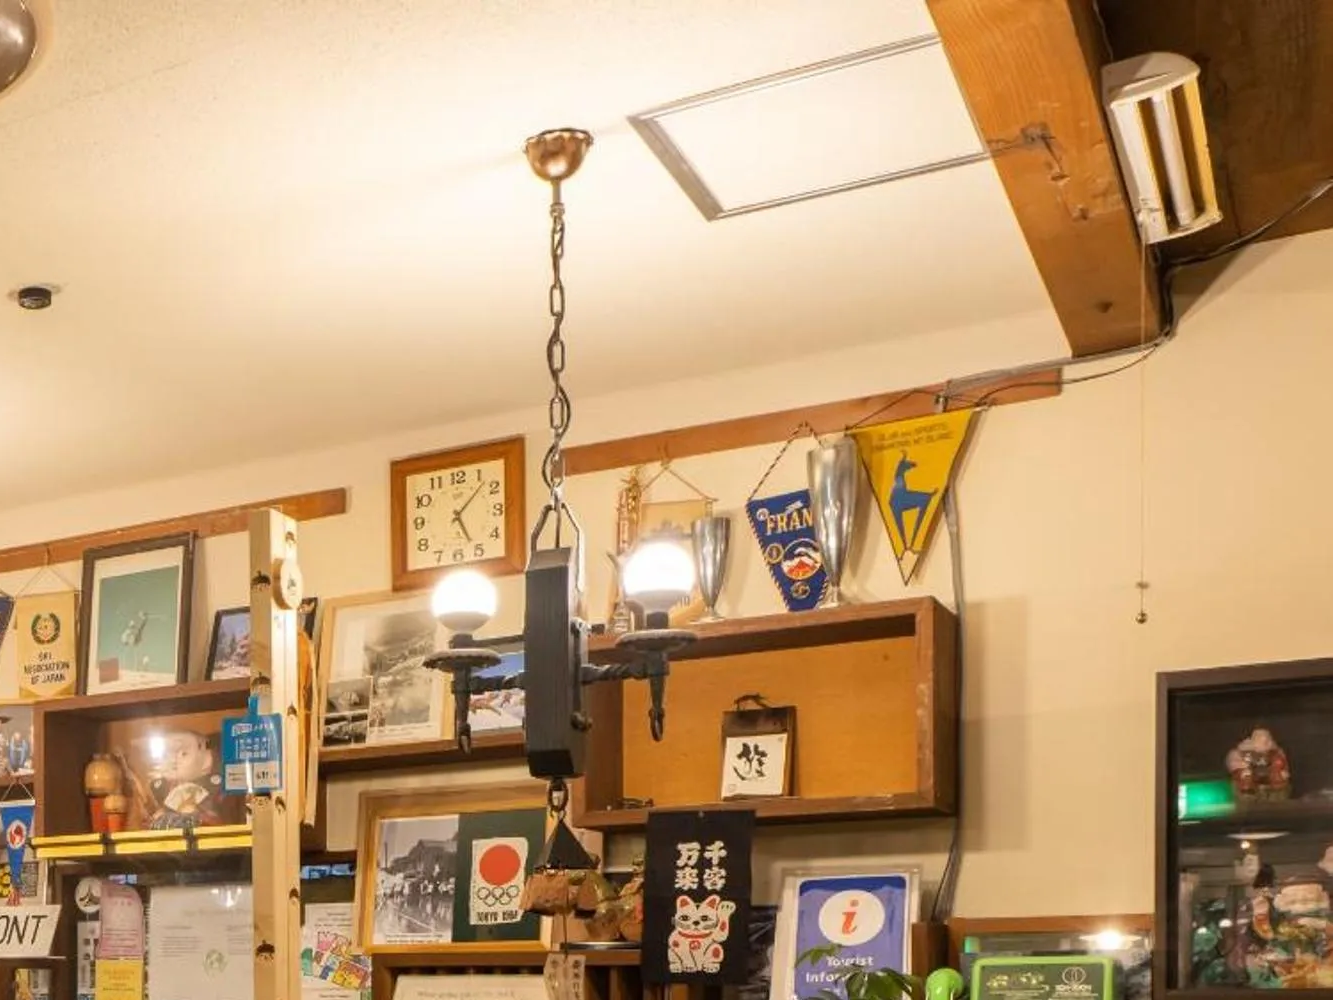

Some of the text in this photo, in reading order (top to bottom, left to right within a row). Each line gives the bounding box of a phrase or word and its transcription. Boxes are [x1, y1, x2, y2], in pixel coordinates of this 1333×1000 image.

[449, 470, 467, 485] 12
[475, 469, 482, 482] 1
[429, 477, 443, 490] 11
[489, 481, 500, 494] 2
[415, 493, 433, 508] 10
[492, 503, 504, 517] 3
[413, 516, 425, 530] 9
[764, 508, 814, 536] FRAN
[489, 526, 500, 540] 4
[417, 538, 430, 552] 8
[474, 543, 485, 557] 5
[433, 550, 443, 563] 7
[452, 549, 464, 562] 6
[824, 954, 874, 968] Tourist
